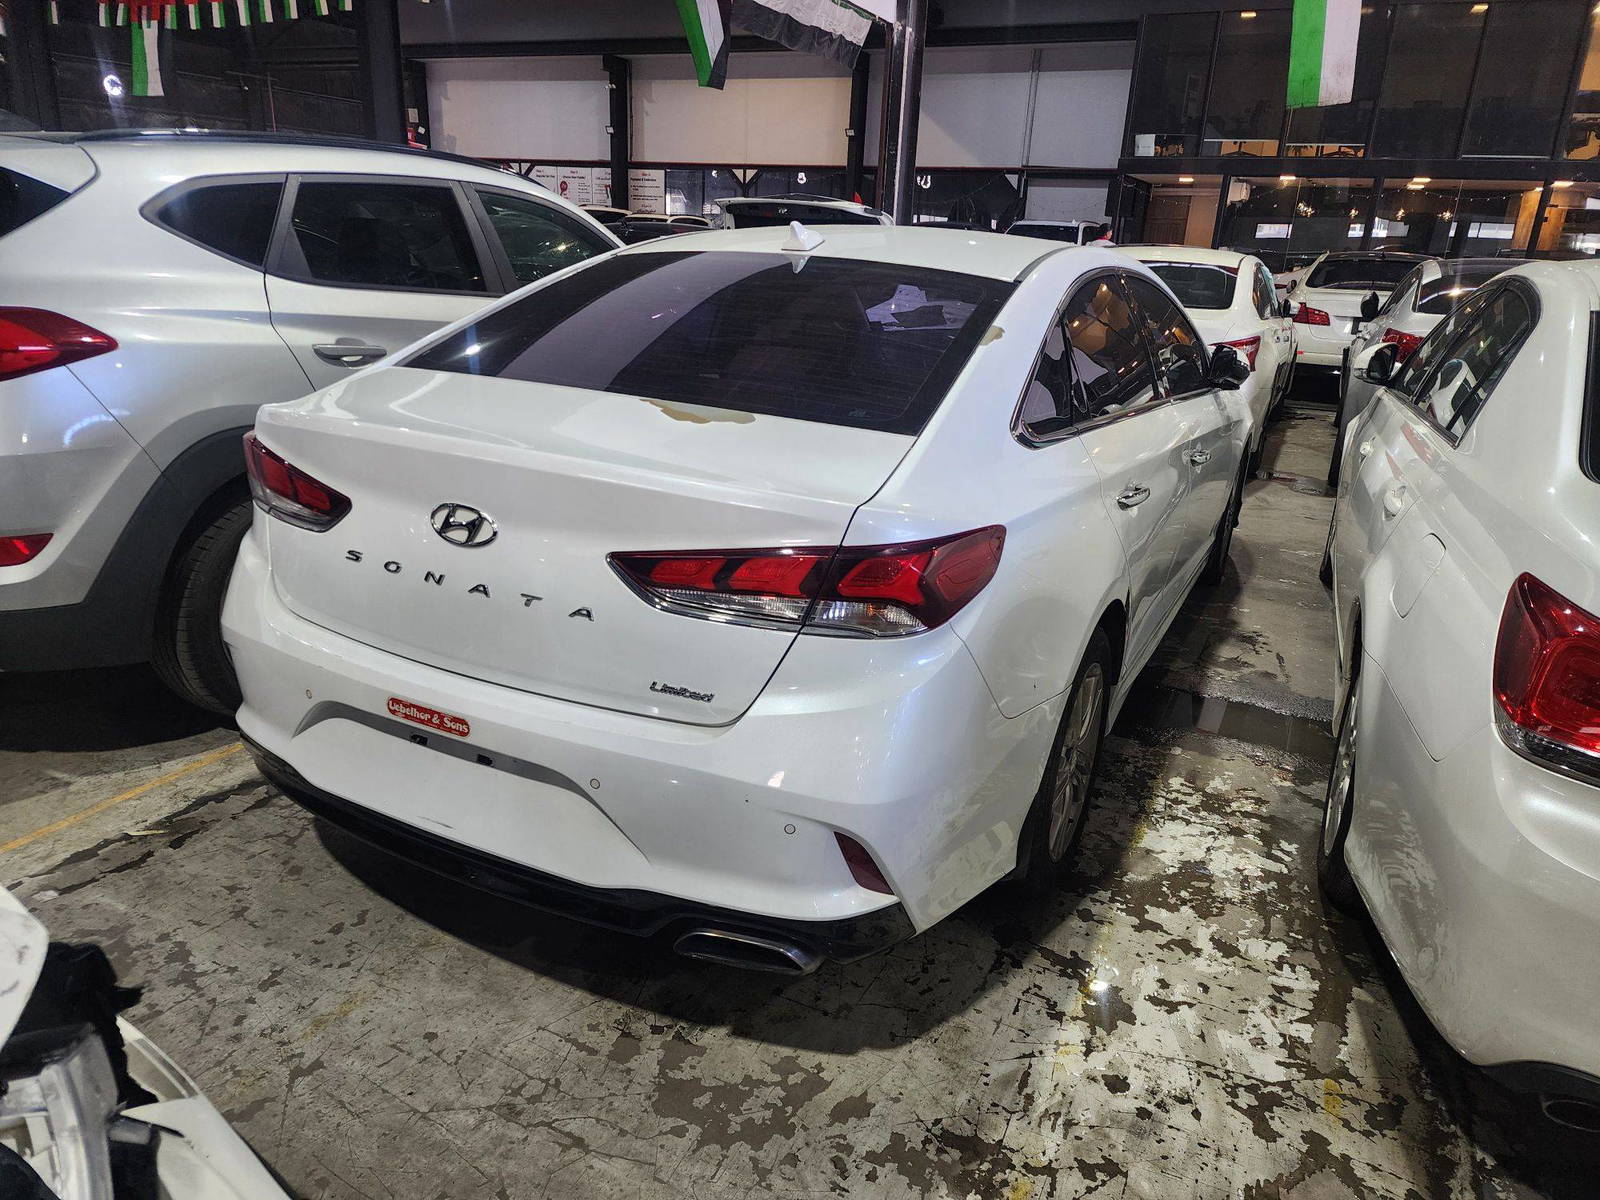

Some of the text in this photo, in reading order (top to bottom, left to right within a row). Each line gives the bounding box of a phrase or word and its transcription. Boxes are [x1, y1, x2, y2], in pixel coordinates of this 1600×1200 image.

[345, 550, 595, 622] SONATA
[649, 681, 715, 703] Limited
[431, 714, 440, 724] &
[443, 716, 469, 733] Sons
